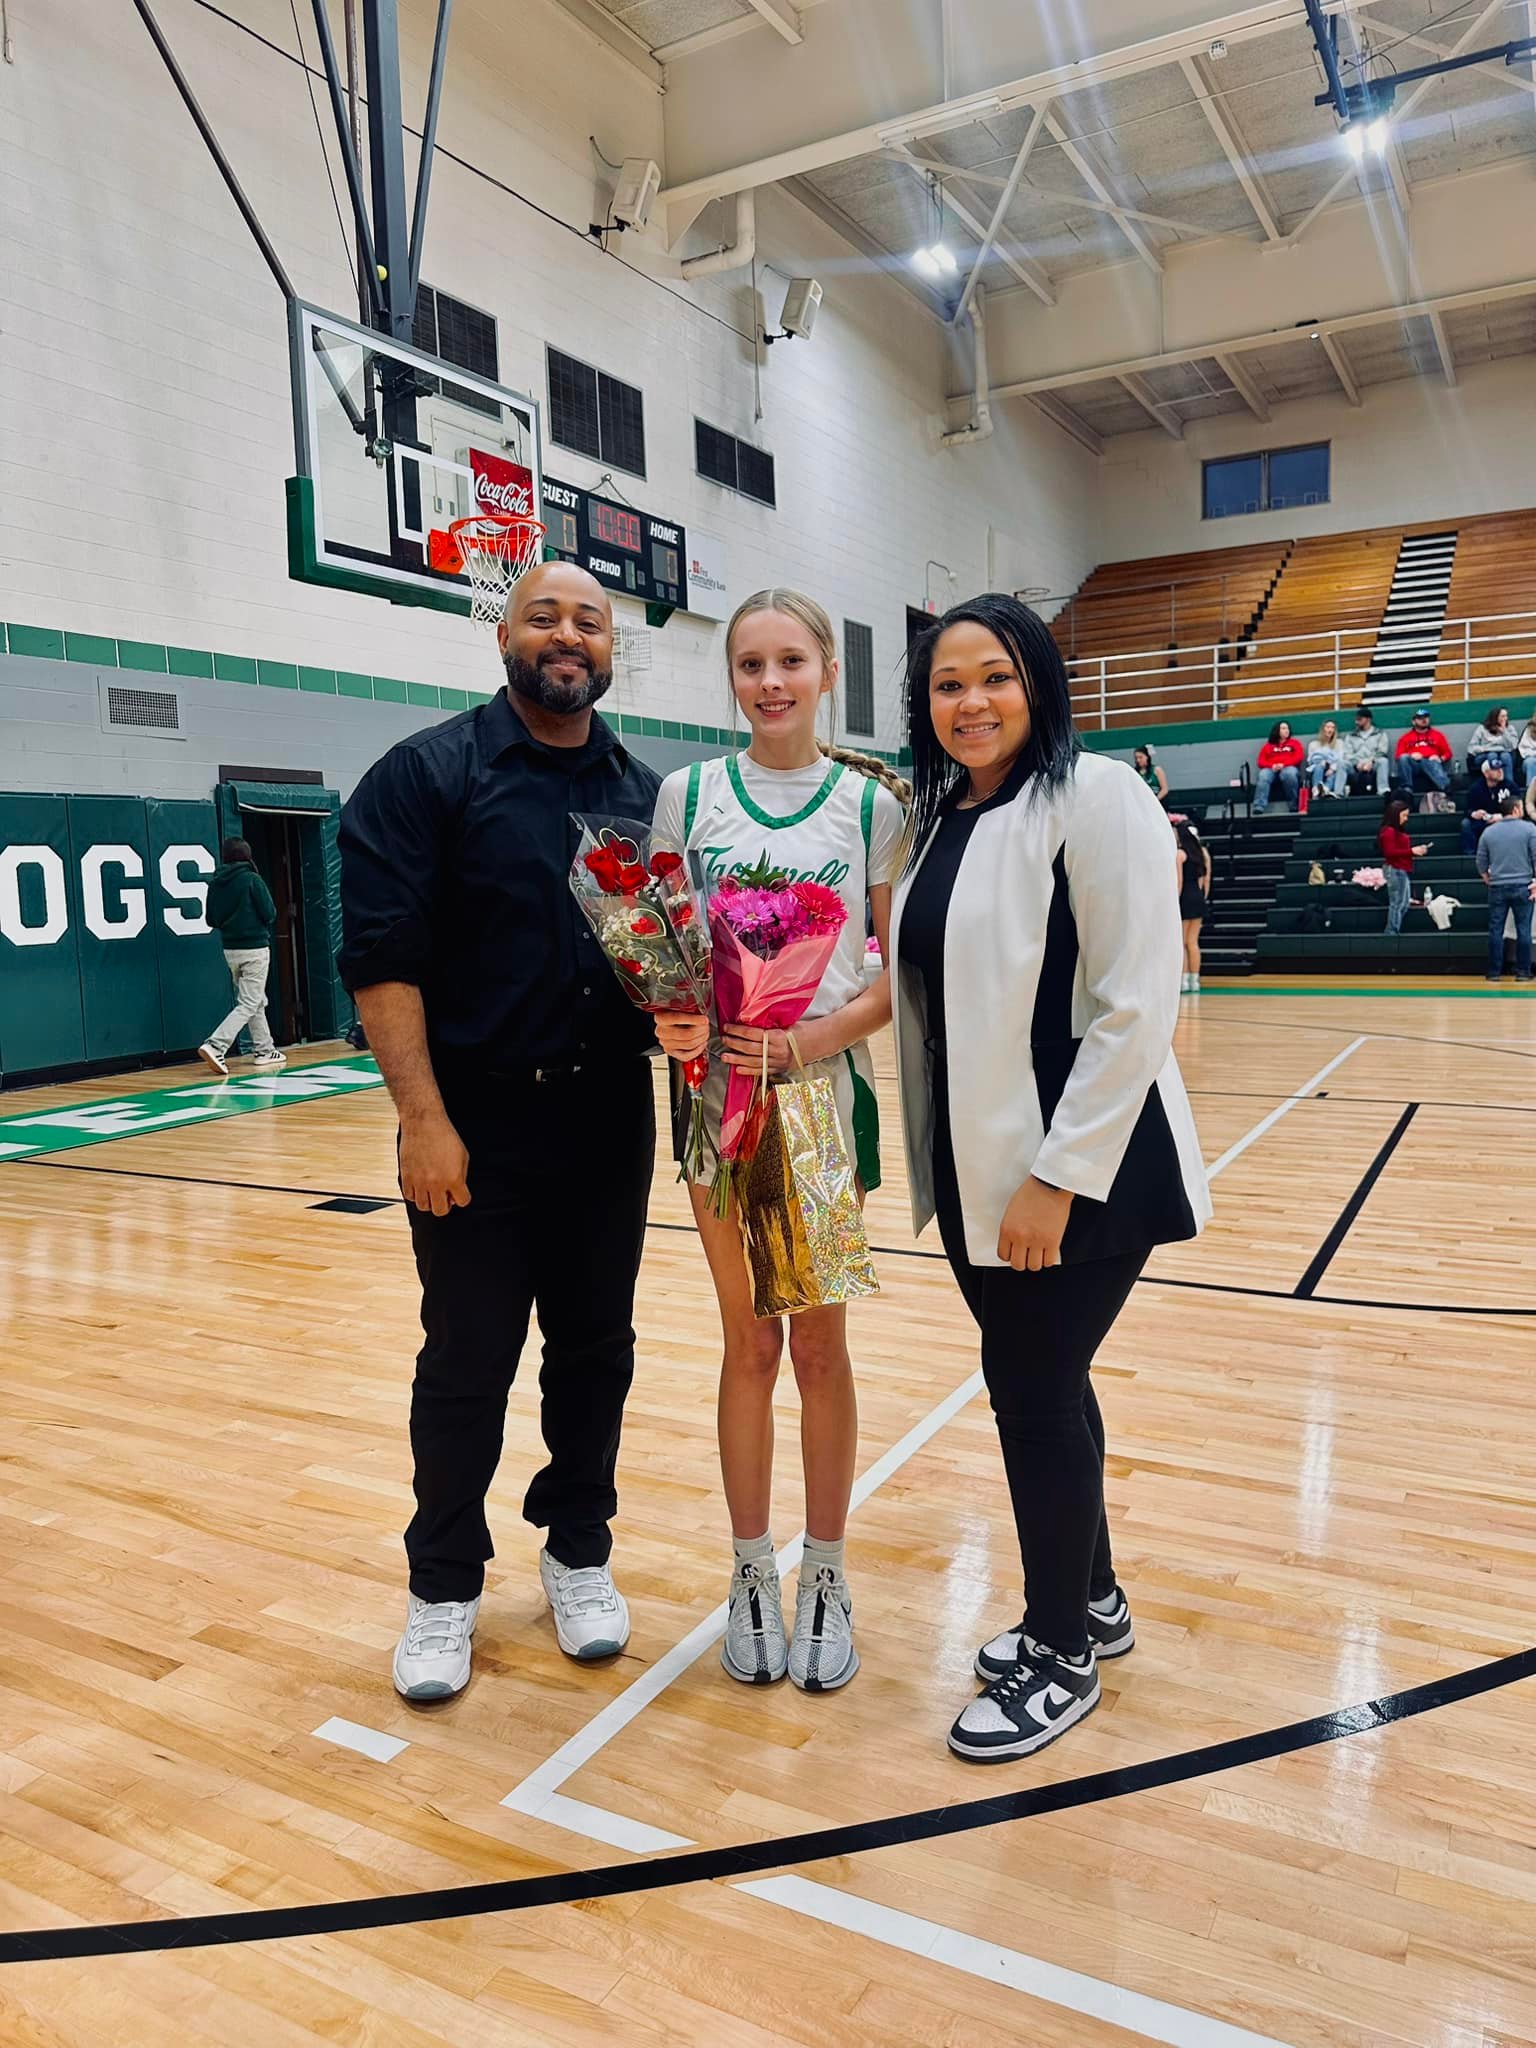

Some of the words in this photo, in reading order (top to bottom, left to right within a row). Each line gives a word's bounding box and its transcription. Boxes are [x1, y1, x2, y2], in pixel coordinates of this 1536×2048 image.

[650, 521, 679, 545] HOME
[589, 555, 621, 577] PERIOD
[0, 844, 216, 946] OGS
